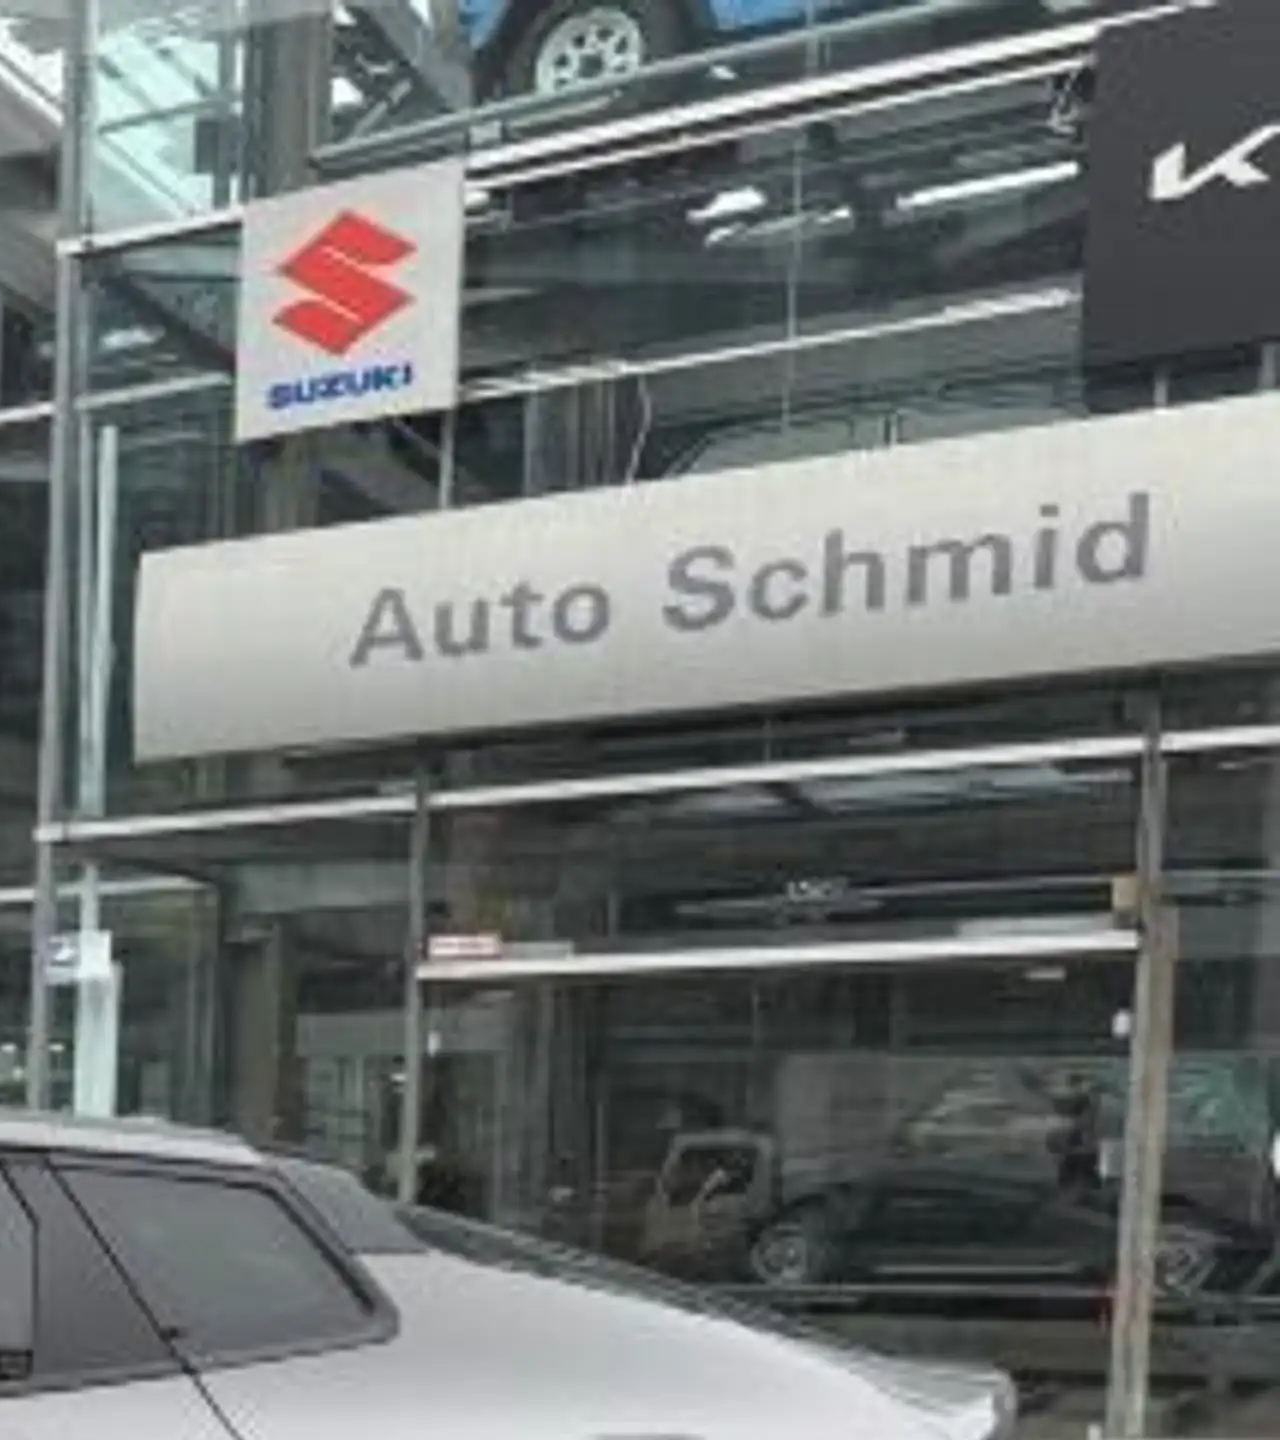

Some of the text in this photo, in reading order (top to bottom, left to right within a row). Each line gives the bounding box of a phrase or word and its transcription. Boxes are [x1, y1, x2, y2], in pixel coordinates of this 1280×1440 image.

[268, 363, 412, 409] SUZUKI
[349, 492, 1151, 668] Auto Schmid
